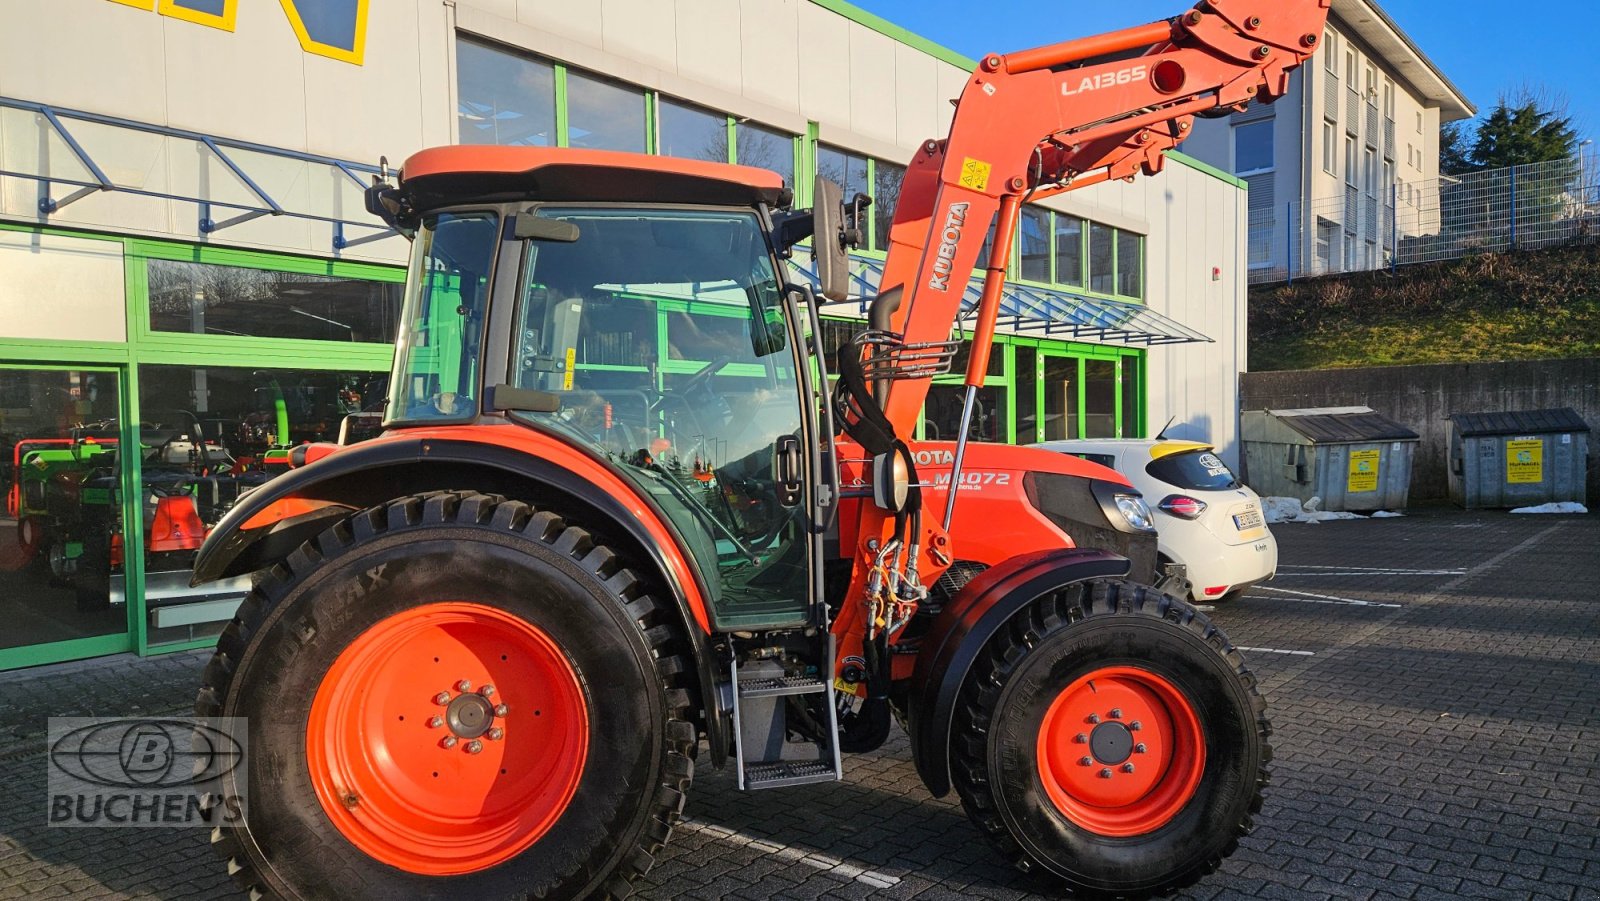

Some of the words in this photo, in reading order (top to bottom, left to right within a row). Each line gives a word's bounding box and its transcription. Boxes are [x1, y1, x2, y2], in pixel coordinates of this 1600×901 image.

[1061, 65, 1146, 96] LA1365
[929, 202, 970, 292] KUBOTA
[910, 450, 955, 465] BOTA
[935, 473, 1010, 485] M4072
